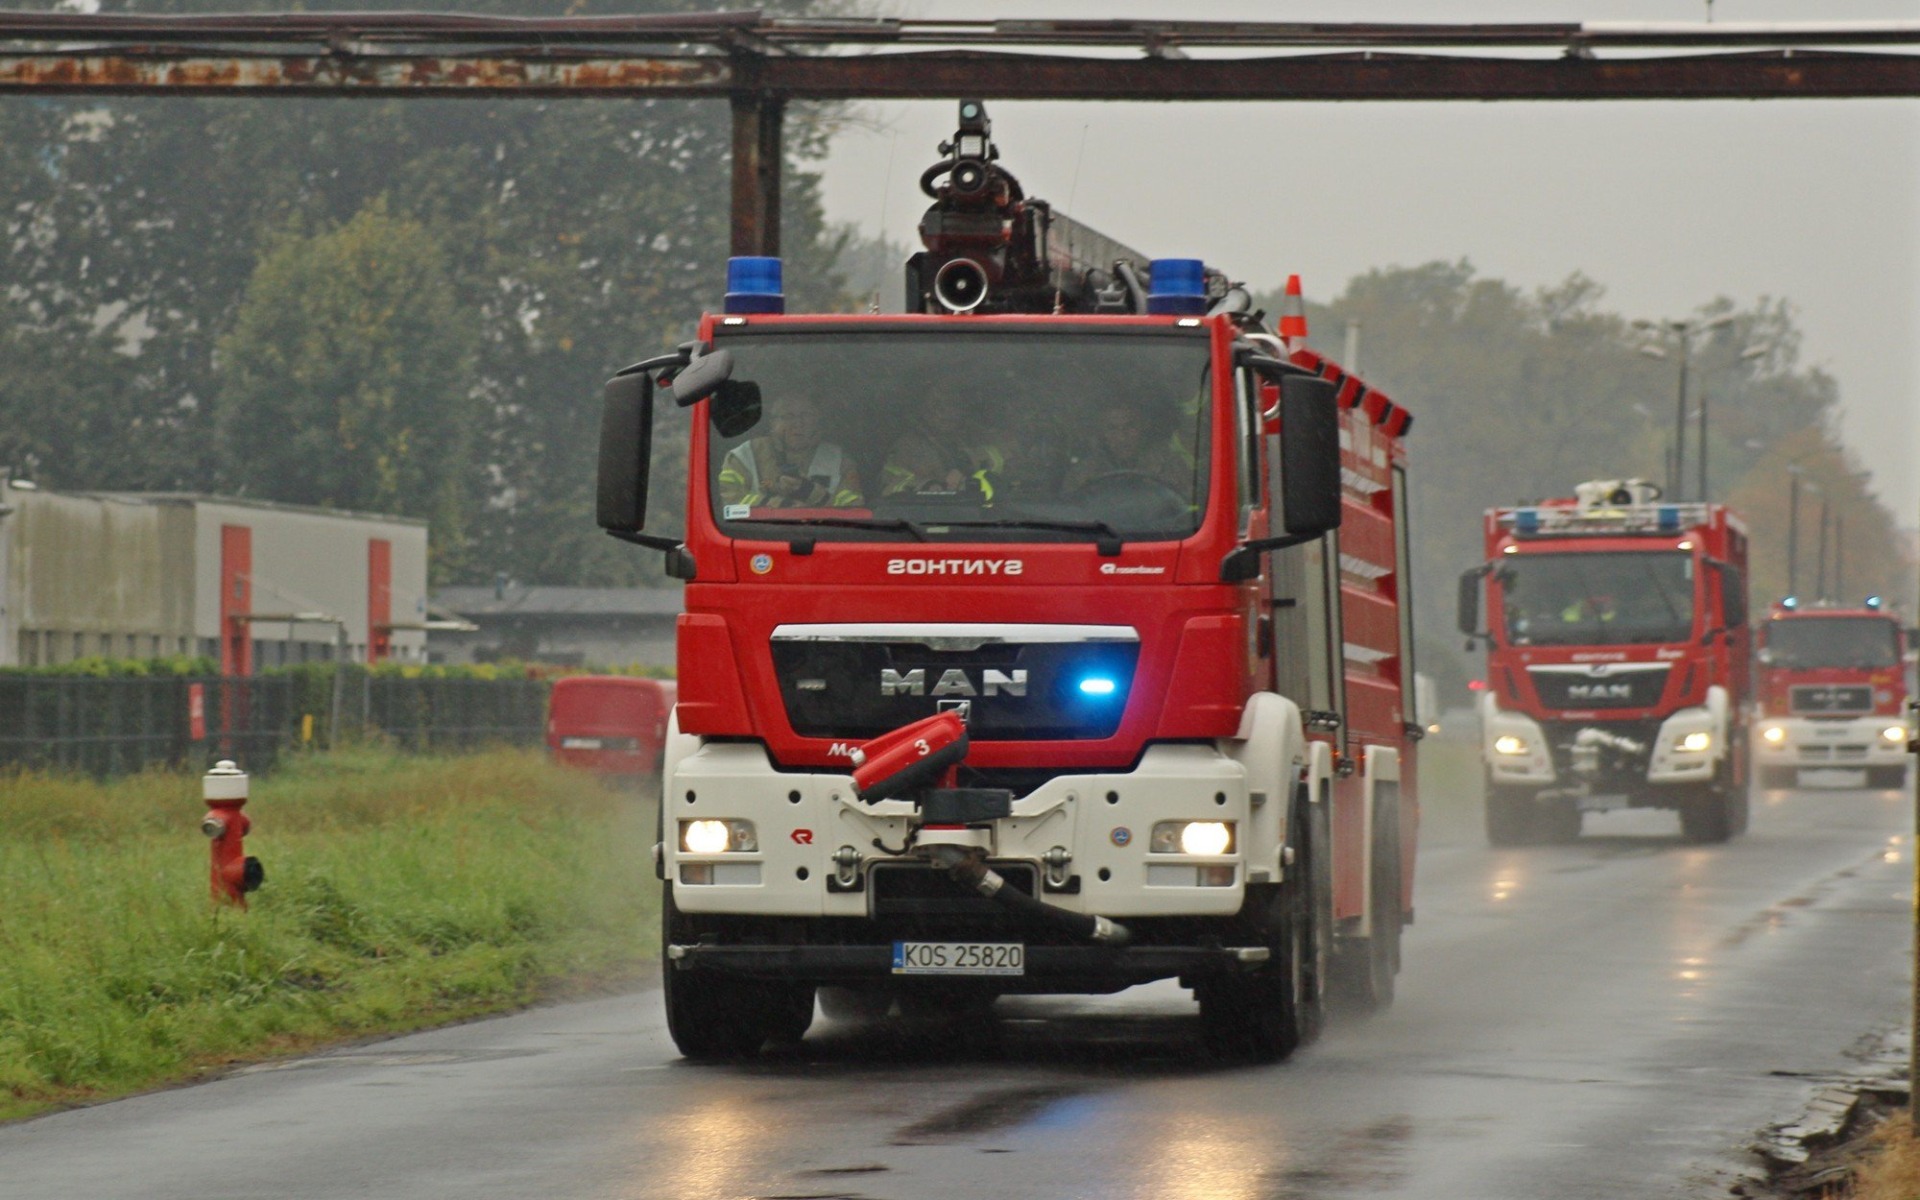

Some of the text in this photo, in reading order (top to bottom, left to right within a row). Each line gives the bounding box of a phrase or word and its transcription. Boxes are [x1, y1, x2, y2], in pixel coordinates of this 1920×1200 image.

[881, 668, 1028, 697] MAN
[1568, 684, 1631, 698] MAN
[914, 739, 930, 755] 3
[905, 945, 1021, 968] KOS 25820
